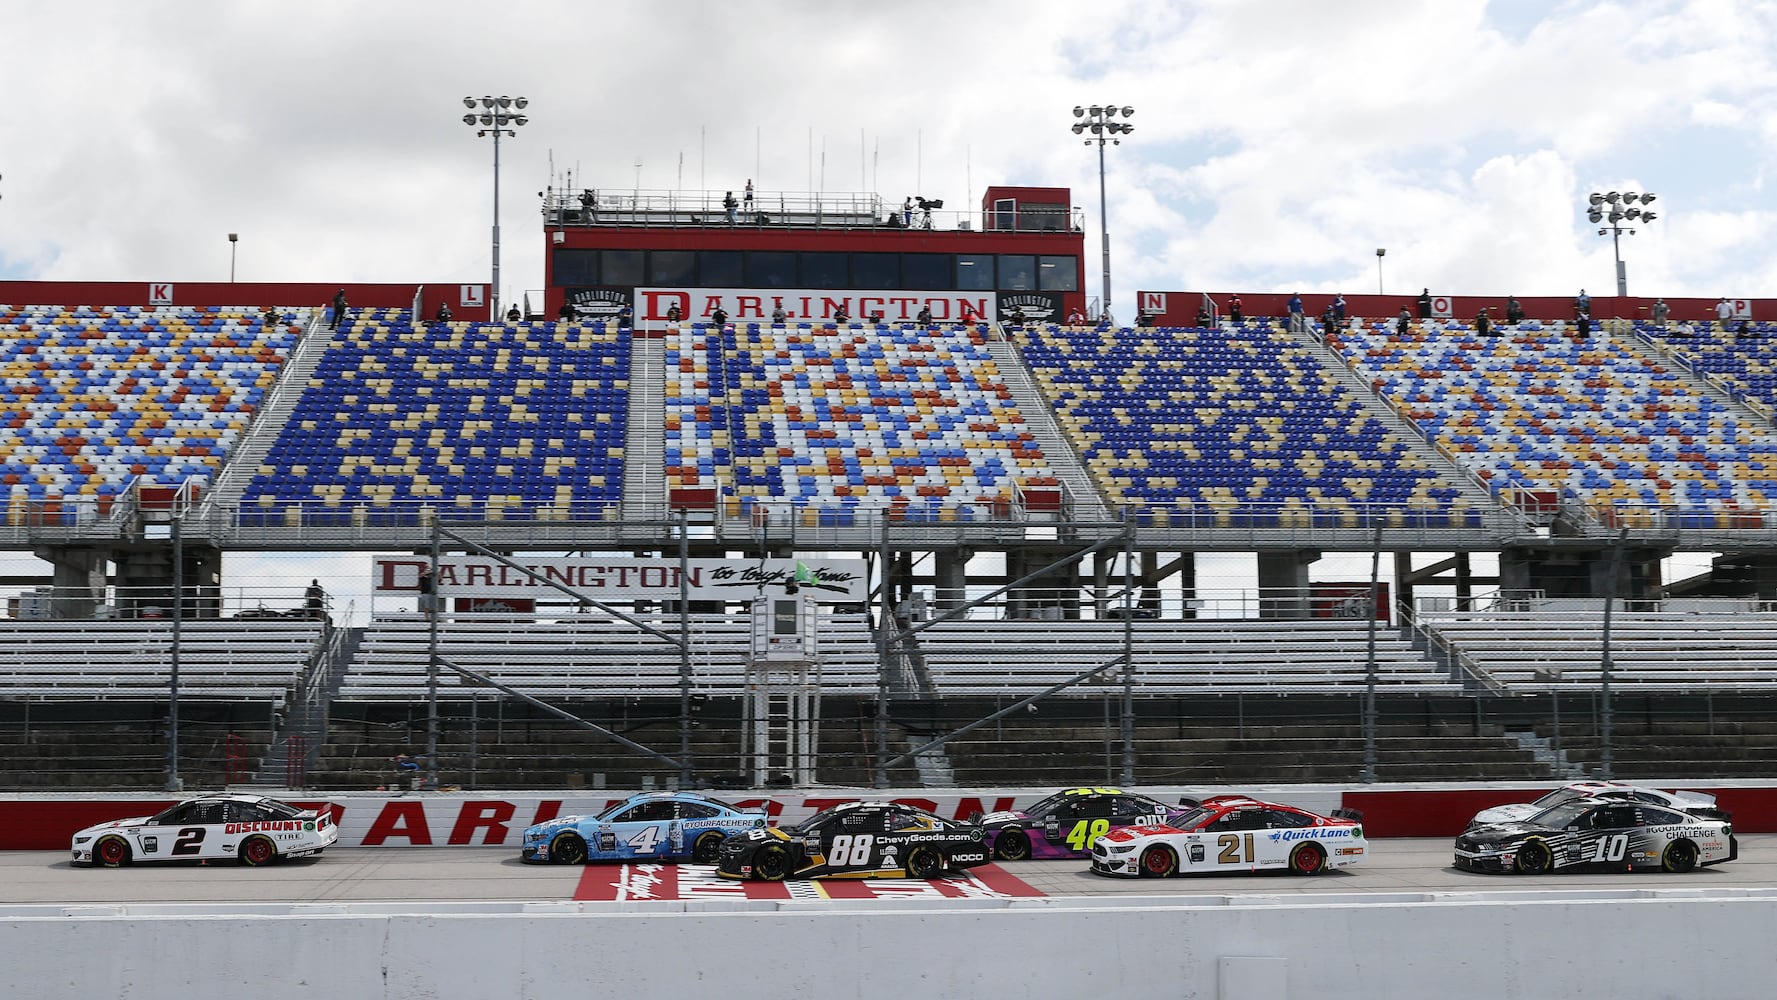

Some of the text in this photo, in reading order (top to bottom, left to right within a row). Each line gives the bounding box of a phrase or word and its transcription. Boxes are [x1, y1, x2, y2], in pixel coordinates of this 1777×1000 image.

[154, 285, 168, 299] K
[467, 286, 477, 301] L
[641, 291, 988, 321] DARLINGTON
[1149, 294, 1162, 308] N
[1434, 298, 1448, 312] O
[1735, 300, 1745, 314] P
[376, 561, 703, 590] DARLINGTON
[225, 821, 303, 834] DISCOUNT
[683, 820, 754, 829] #YOURFACEHERE
[627, 825, 660, 854] 4
[876, 833, 971, 846] ChevyGoods.com
[1066, 819, 1110, 851] 48
[1282, 828, 1350, 841] Quick Lane
[1666, 829, 1716, 839] CHALLENGE
[171, 827, 207, 856] 2
[1217, 833, 1255, 864] 21
[1590, 834, 1629, 862] 10
[828, 835, 874, 866] 88
[952, 854, 983, 862] NOCO
